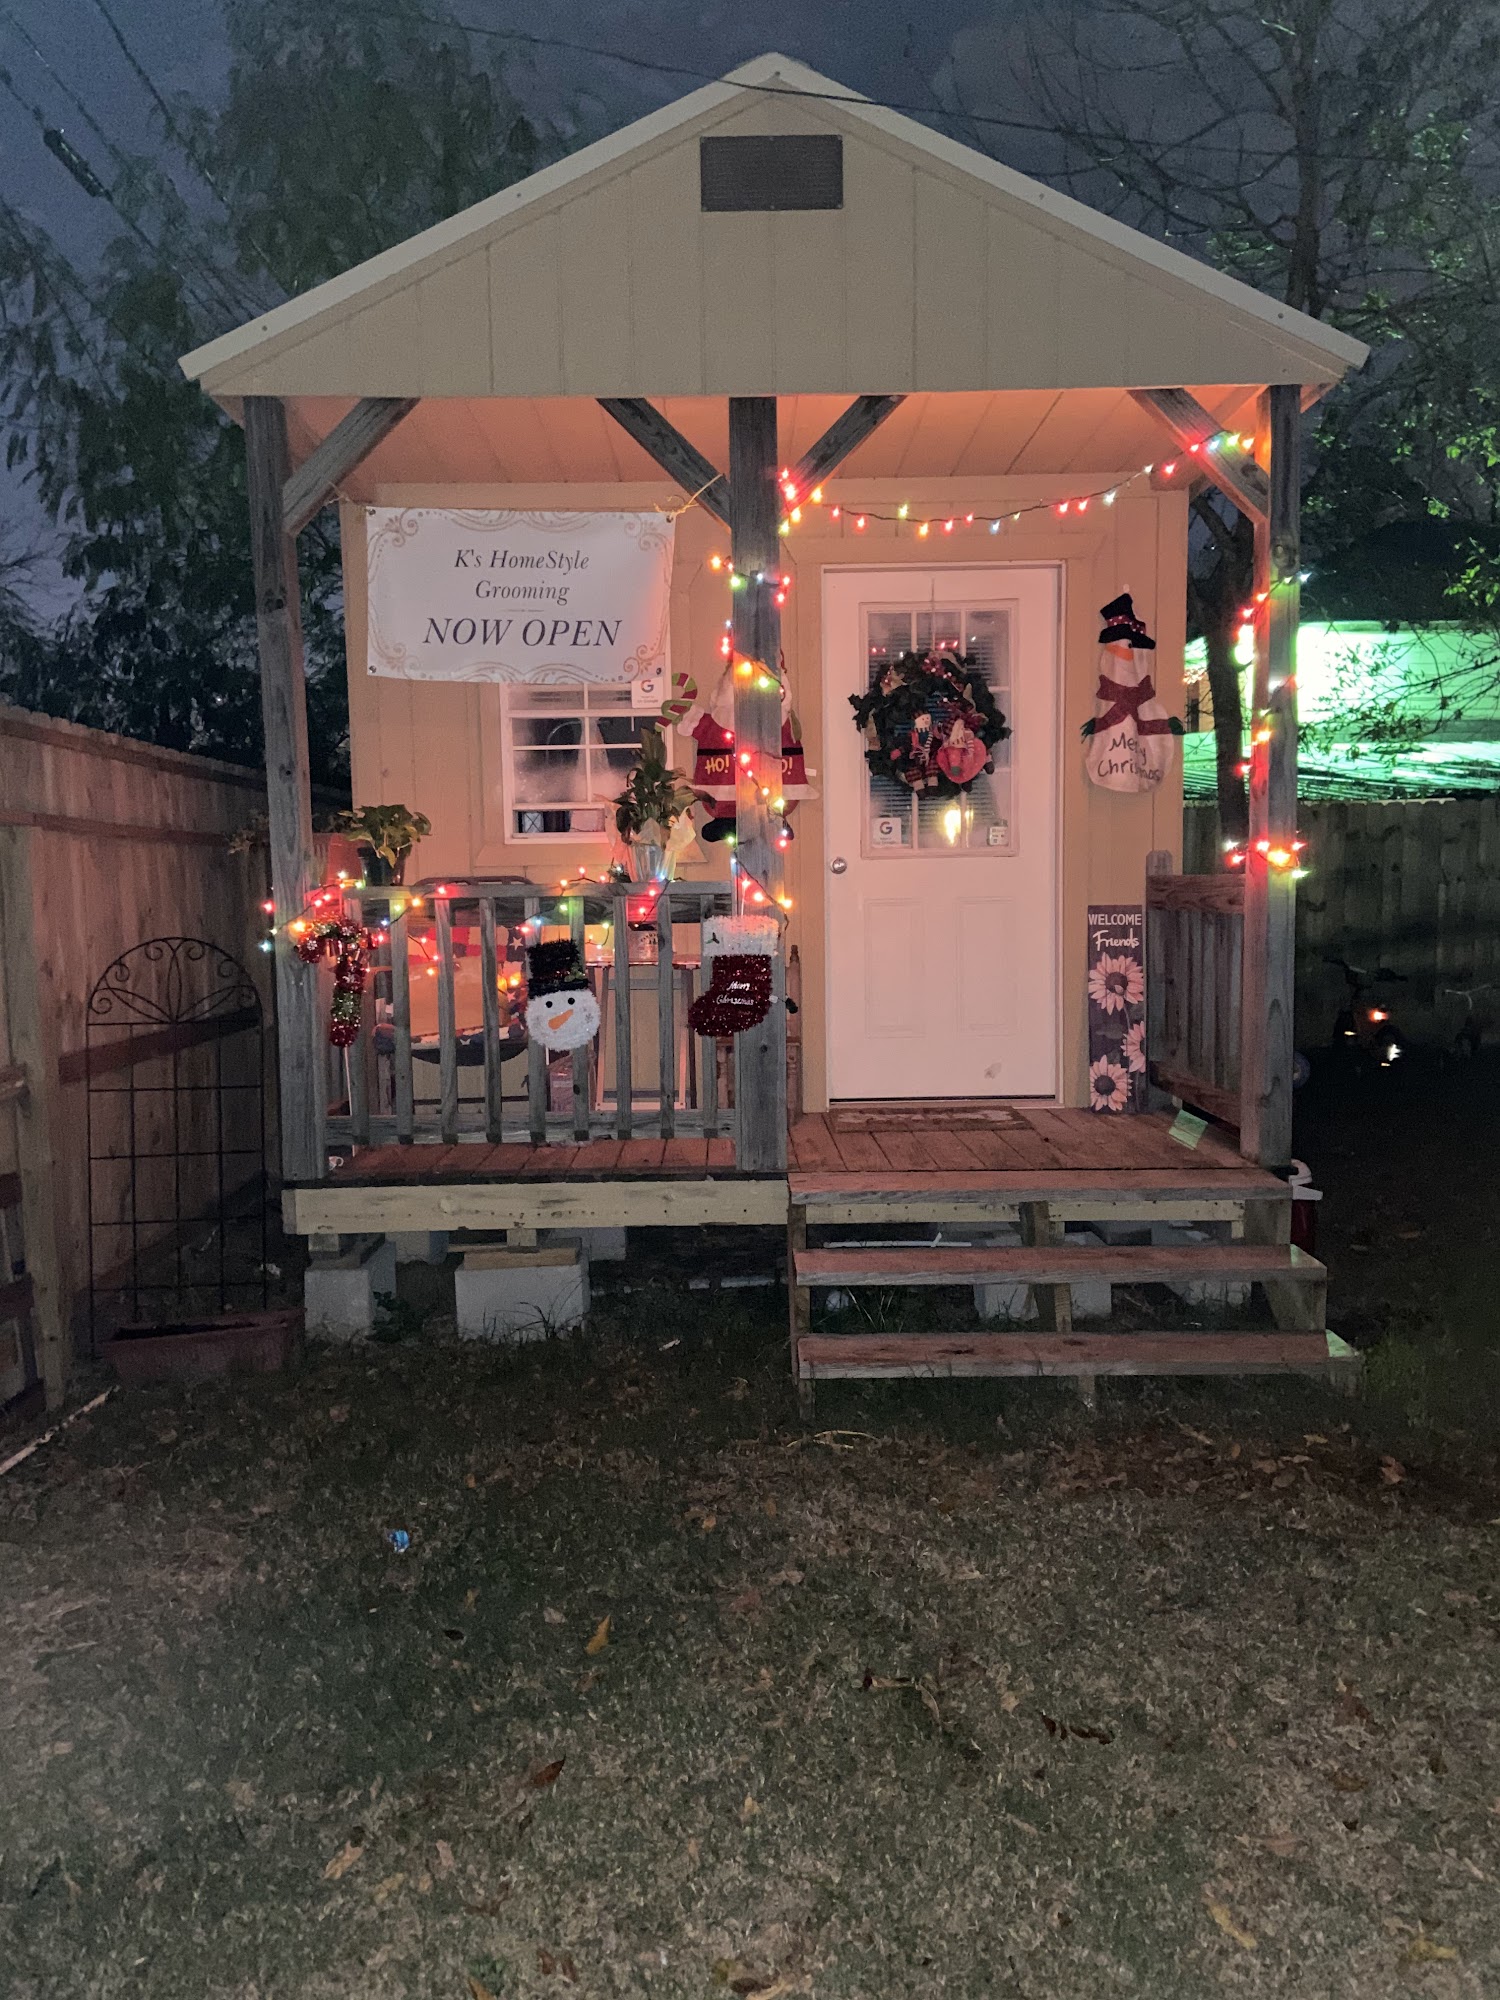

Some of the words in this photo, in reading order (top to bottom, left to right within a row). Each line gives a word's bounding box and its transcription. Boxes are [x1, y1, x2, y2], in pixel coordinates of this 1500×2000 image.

[454, 549, 482, 569] K's
[490, 550, 590, 575] HomeStyle
[475, 580, 570, 605] Grooming
[422, 617, 514, 646] NOW
[521, 619, 623, 647] OPEN
[641, 679, 654, 693] G
[1108, 732, 1146, 766] Mey
[704, 754, 730, 775] HO!
[781, 756, 793, 775] O!
[1097, 759, 1161, 781] Chrimas
[880, 821, 893, 835] G
[1088, 913, 1142, 926] WELCOME
[1092, 927, 1140, 951] Friends
